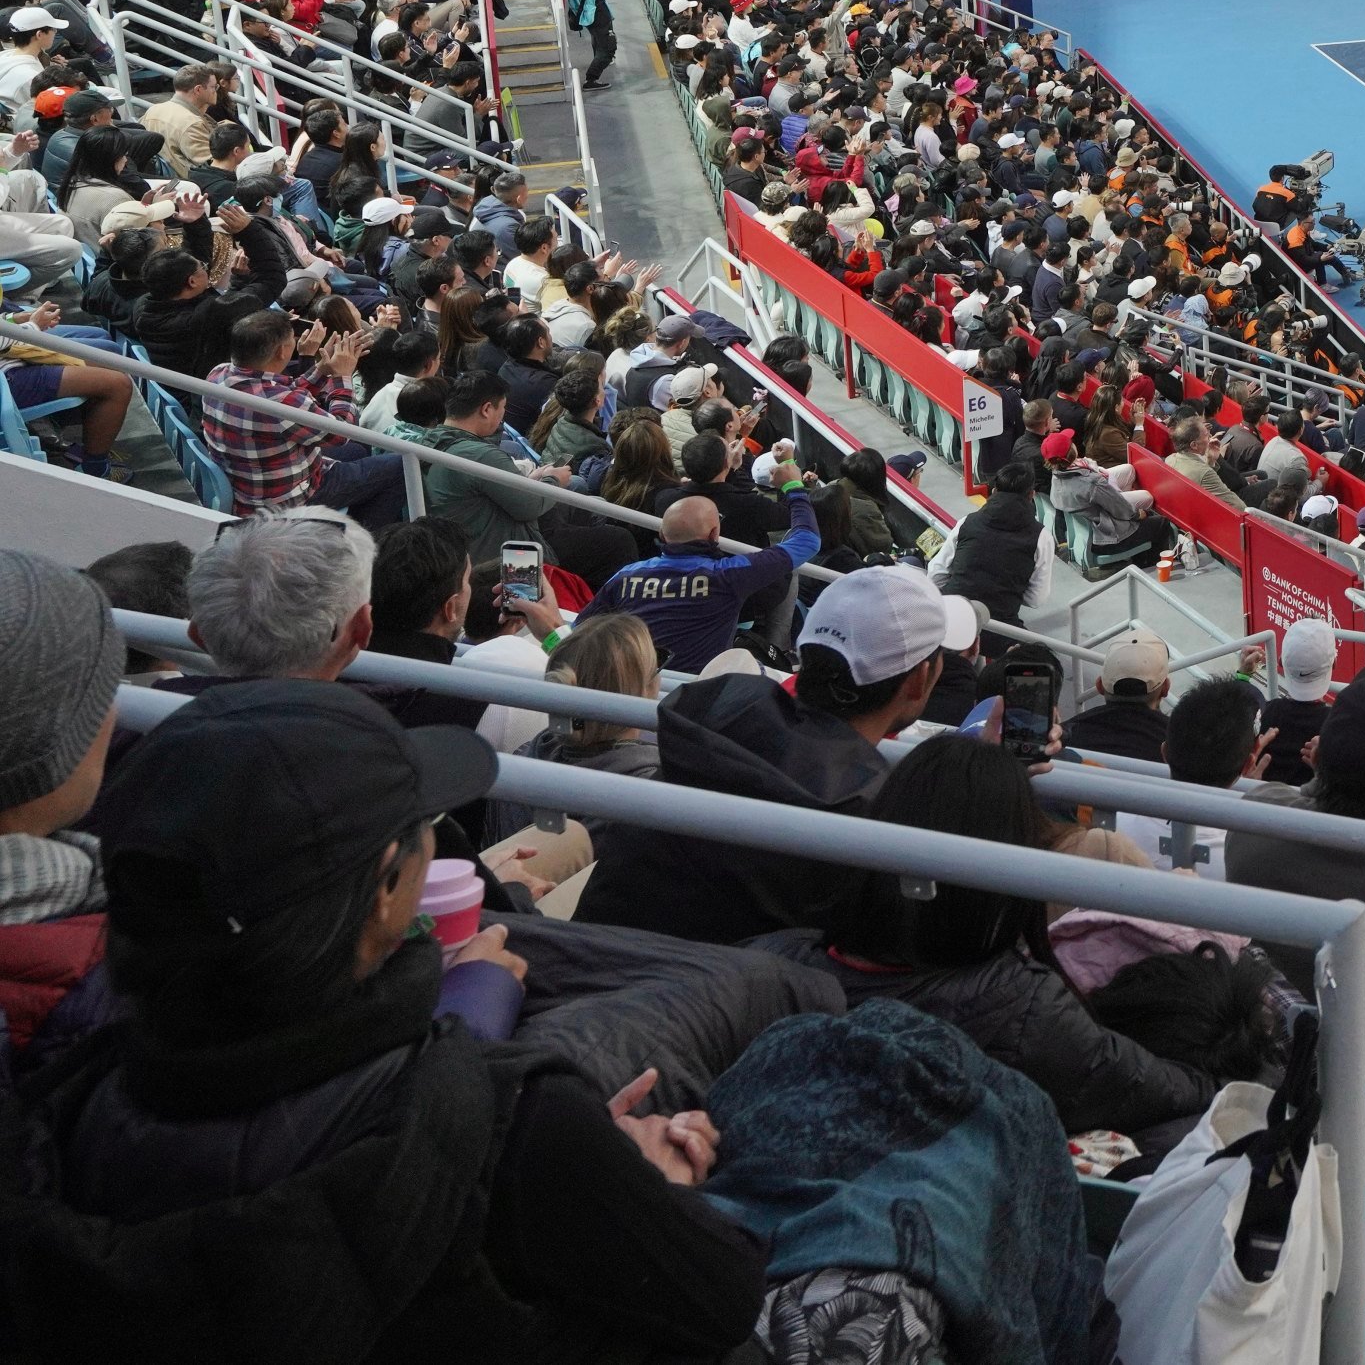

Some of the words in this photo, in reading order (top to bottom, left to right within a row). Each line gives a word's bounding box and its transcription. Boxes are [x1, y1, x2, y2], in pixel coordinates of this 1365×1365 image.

[968, 396, 987, 412] E6
[969, 415, 995, 425] Michelle
[969, 424, 982, 432] Mui
[621, 575, 709, 599] ITALIA
[1271, 574, 1291, 594] BANK
[1291, 584, 1303, 598] OF
[1302, 592, 1326, 612] CHINA
[1267, 595, 1295, 619] TENNIS
